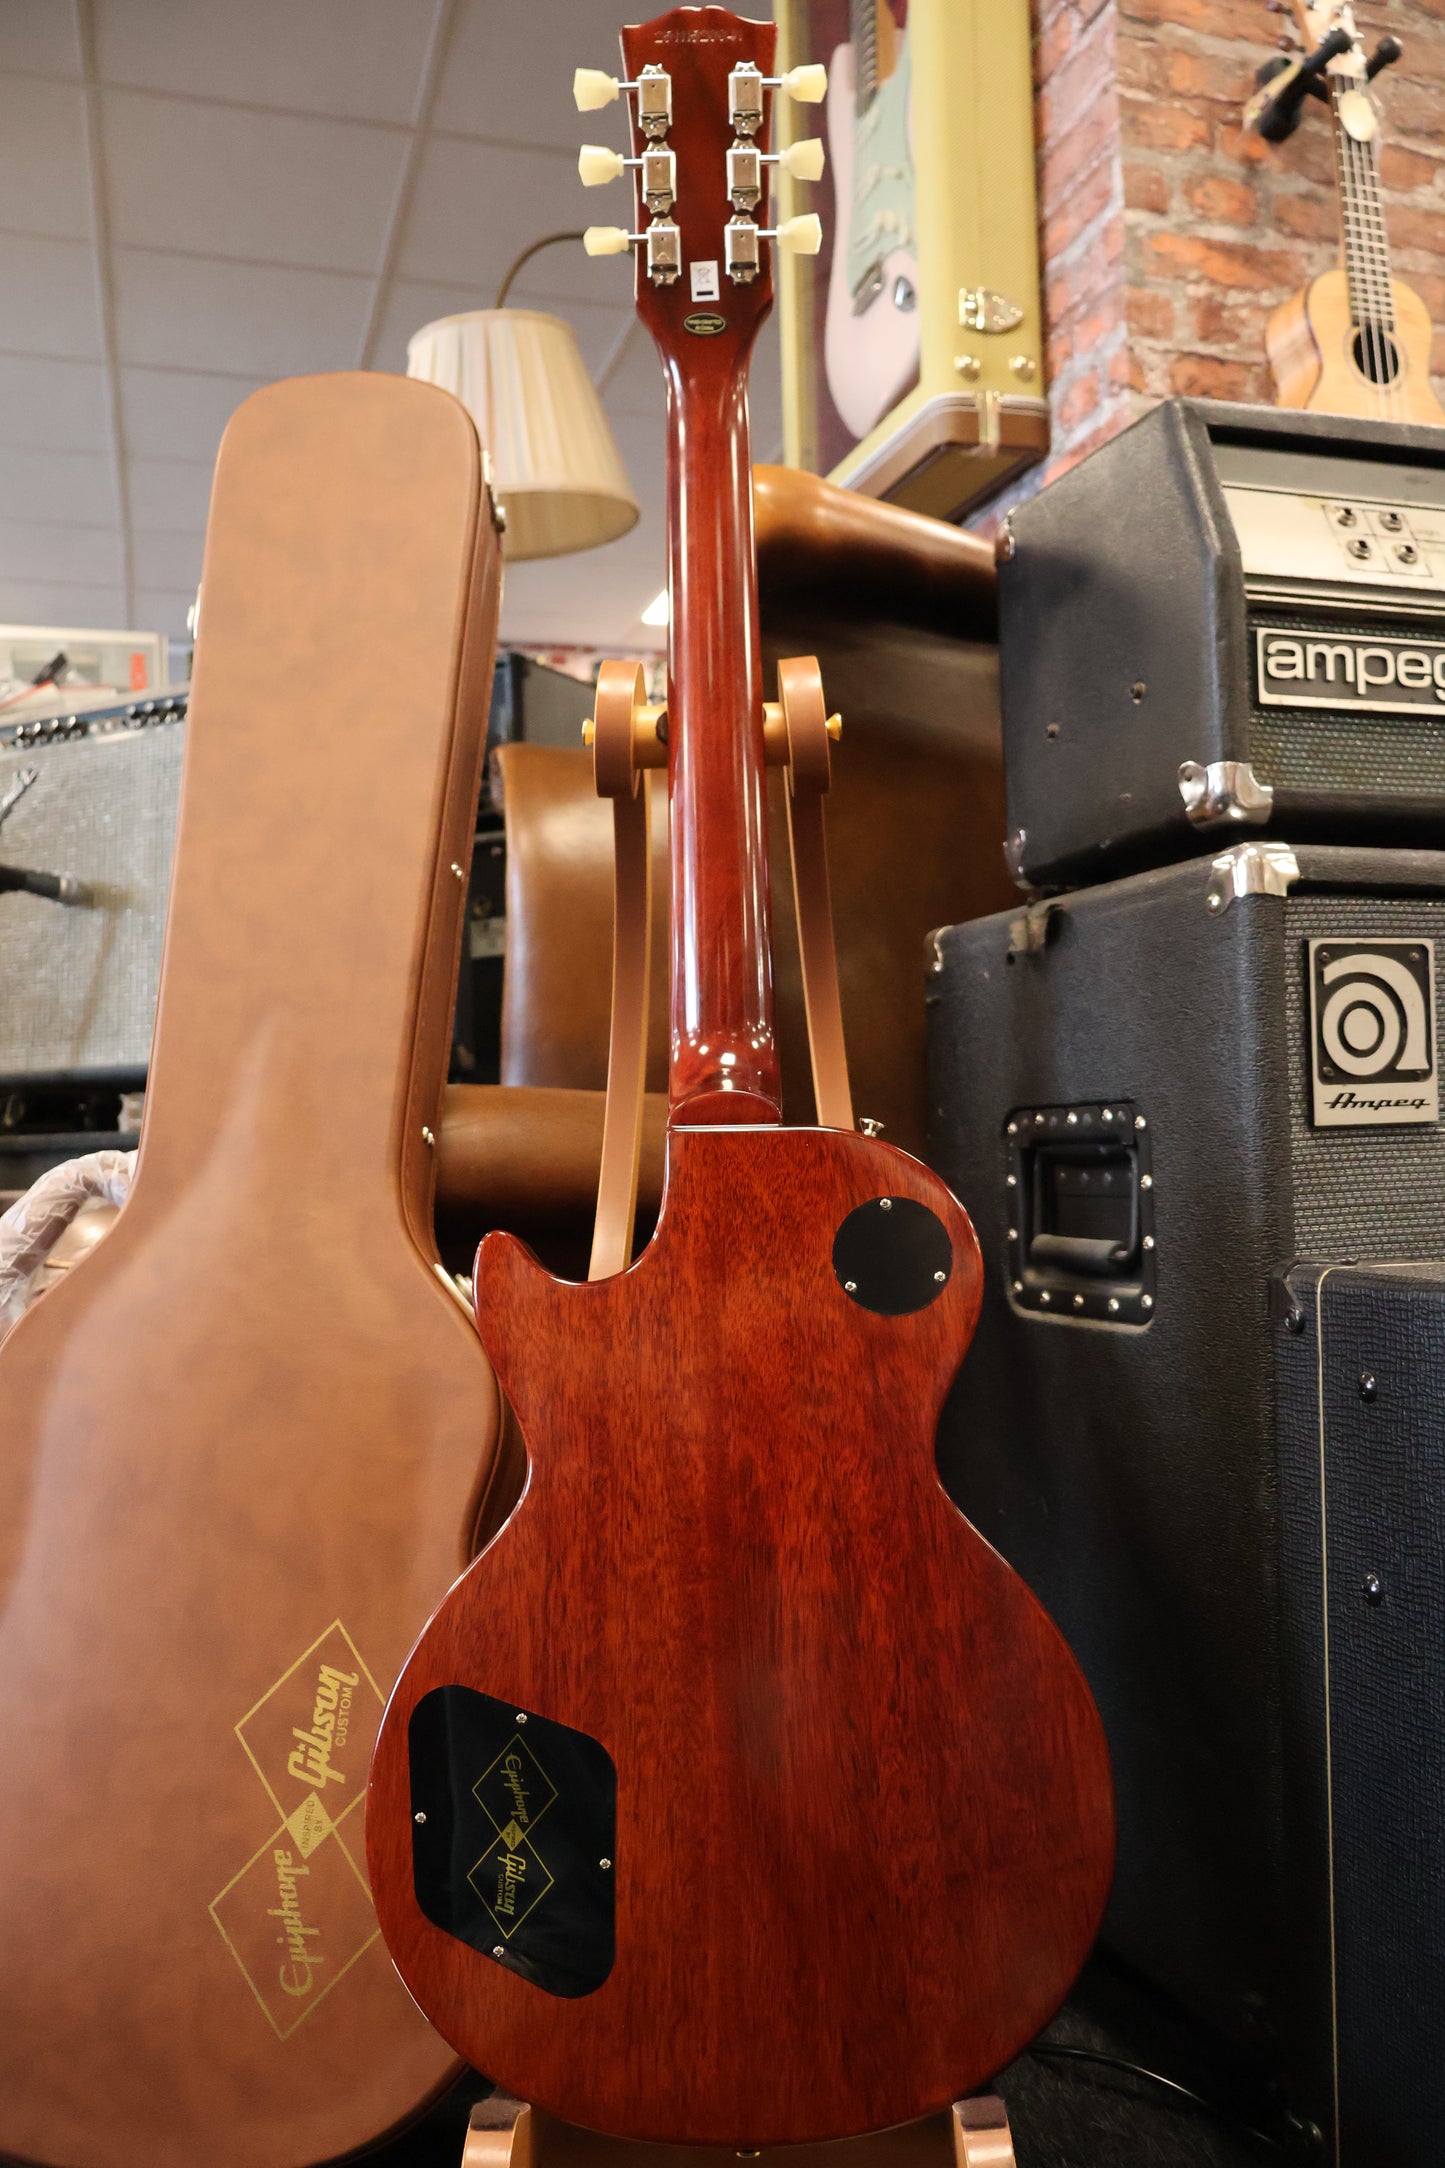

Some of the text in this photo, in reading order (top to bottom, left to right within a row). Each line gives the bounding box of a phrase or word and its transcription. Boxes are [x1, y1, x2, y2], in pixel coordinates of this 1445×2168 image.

[1323, 1092, 1431, 1111] Ampeg
[288, 1664, 360, 1789] Gibson
[335, 1687, 353, 1747] CUSTOM
[500, 1752, 530, 1824] Epiphone
[301, 1800, 316, 1849] INSPIRED
[313, 1820, 324, 1833] BY
[494, 1853, 527, 1916] Gibson
[266, 1849, 326, 1996] Epiphone
